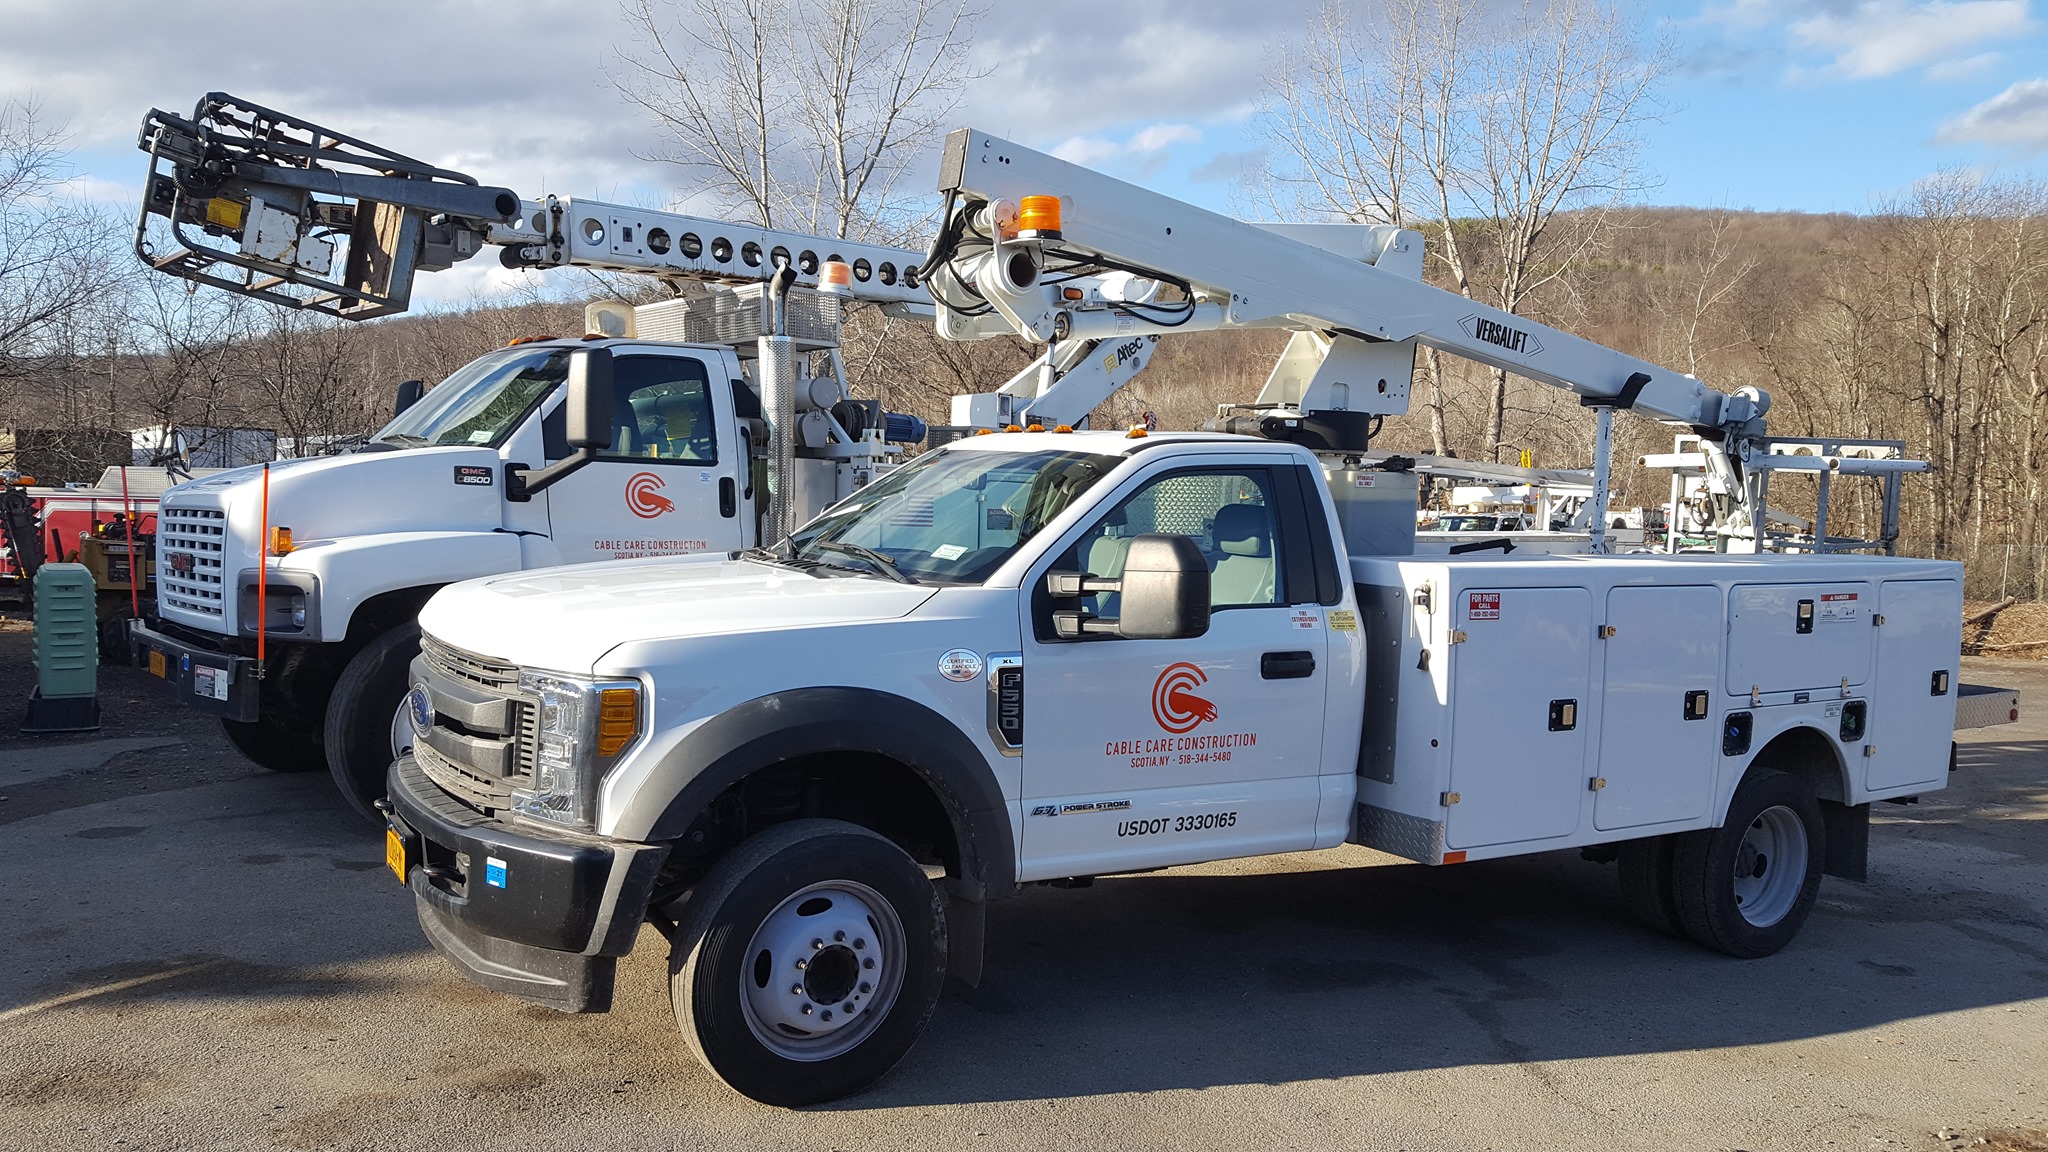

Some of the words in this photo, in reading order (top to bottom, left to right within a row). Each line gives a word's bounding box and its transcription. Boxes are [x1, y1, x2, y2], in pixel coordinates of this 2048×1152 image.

[1475, 317, 1529, 354] VERSALIFT
[1116, 337, 1144, 366] Altec
[456, 475, 491, 484] C8500
[594, 540, 621, 550] CABLE
[624, 540, 645, 550] CARE
[647, 540, 707, 550] CONSTRUCTION
[1471, 594, 1482, 603] FOR
[1482, 594, 1499, 603] PARTS
[1105, 740, 1142, 756] CABLE
[1145, 738, 1174, 753] CARE
[1177, 732, 1257, 751] CONSTRUCTION
[1178, 751, 1232, 765] 518-344-5480
[1063, 803, 1095, 812] POWER
[1095, 800, 1131, 810] STROKE
[1117, 817, 1171, 837] USDOT
[1174, 811, 1238, 832] 3330165
